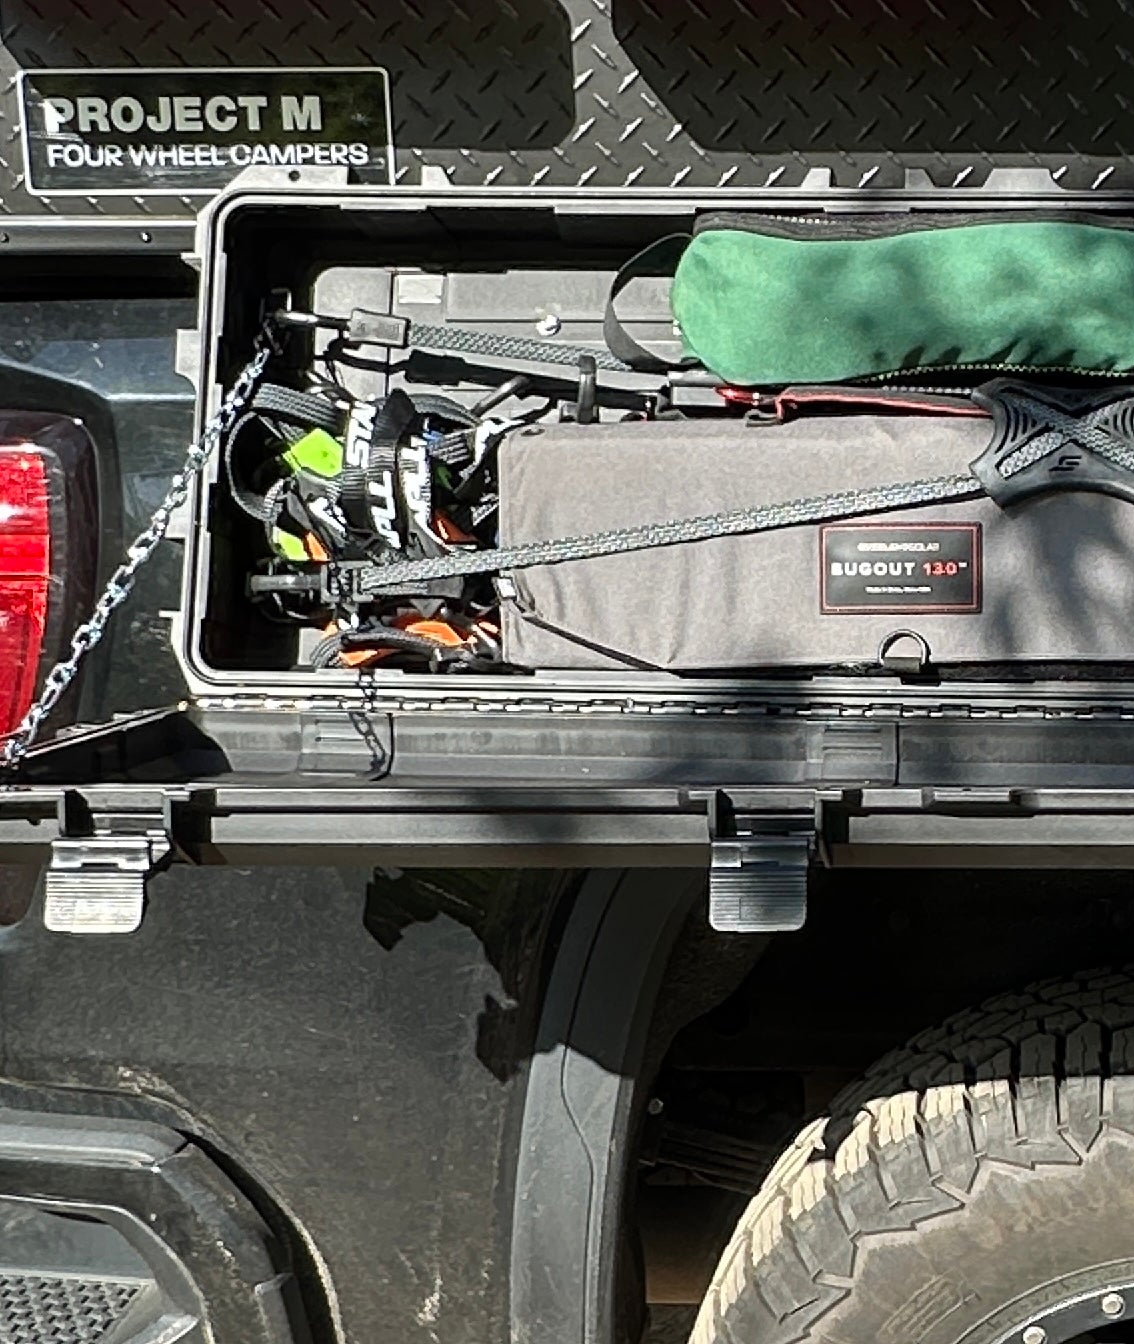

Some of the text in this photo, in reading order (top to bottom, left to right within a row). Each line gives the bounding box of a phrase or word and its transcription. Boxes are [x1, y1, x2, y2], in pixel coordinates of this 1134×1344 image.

[43, 94, 322, 135] PROJECT M
[47, 142, 369, 169] FOUR WHEEL CAMPERS
[830, 562, 916, 576] BUGOUT
